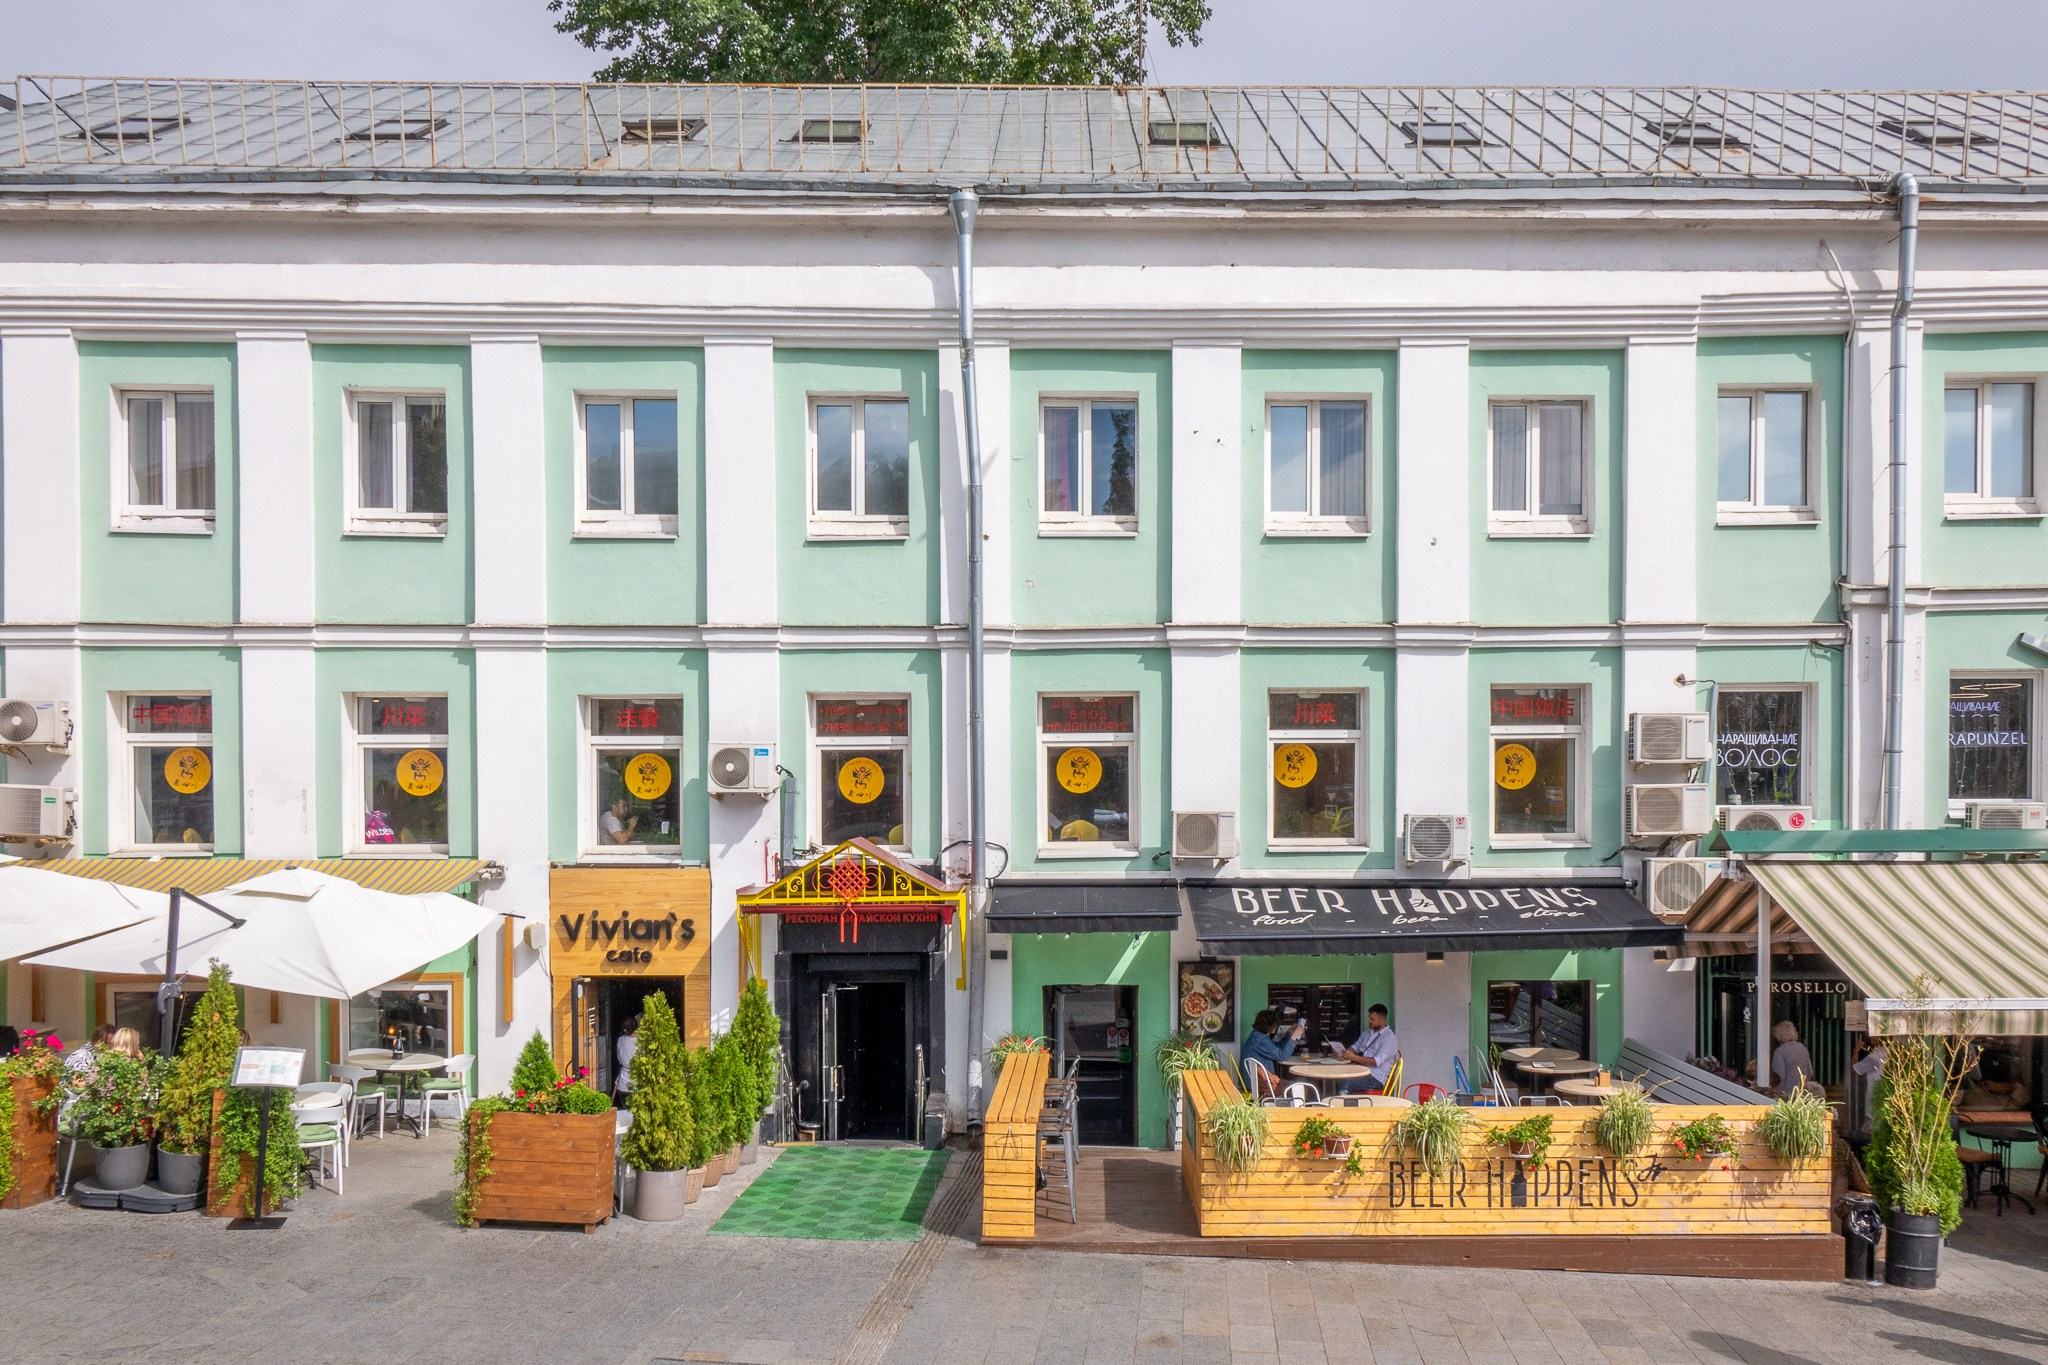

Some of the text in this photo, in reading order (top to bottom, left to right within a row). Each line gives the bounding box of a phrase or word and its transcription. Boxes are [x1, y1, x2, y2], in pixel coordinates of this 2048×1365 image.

[383, 705, 427, 727] 川菜
[616, 707, 660, 729] 送餐
[1293, 702, 1337, 724] 川菜
[1949, 732, 2028, 745] RAPUNZEL
[1716, 748, 1798, 766] ВОЛОС
[1231, 888, 1351, 914] BEER
[785, 915, 838, 923] РЕСТОРАН
[903, 913, 938, 922] КУХНИ
[1252, 914, 1314, 926] food
[606, 947, 653, 963] cafe
